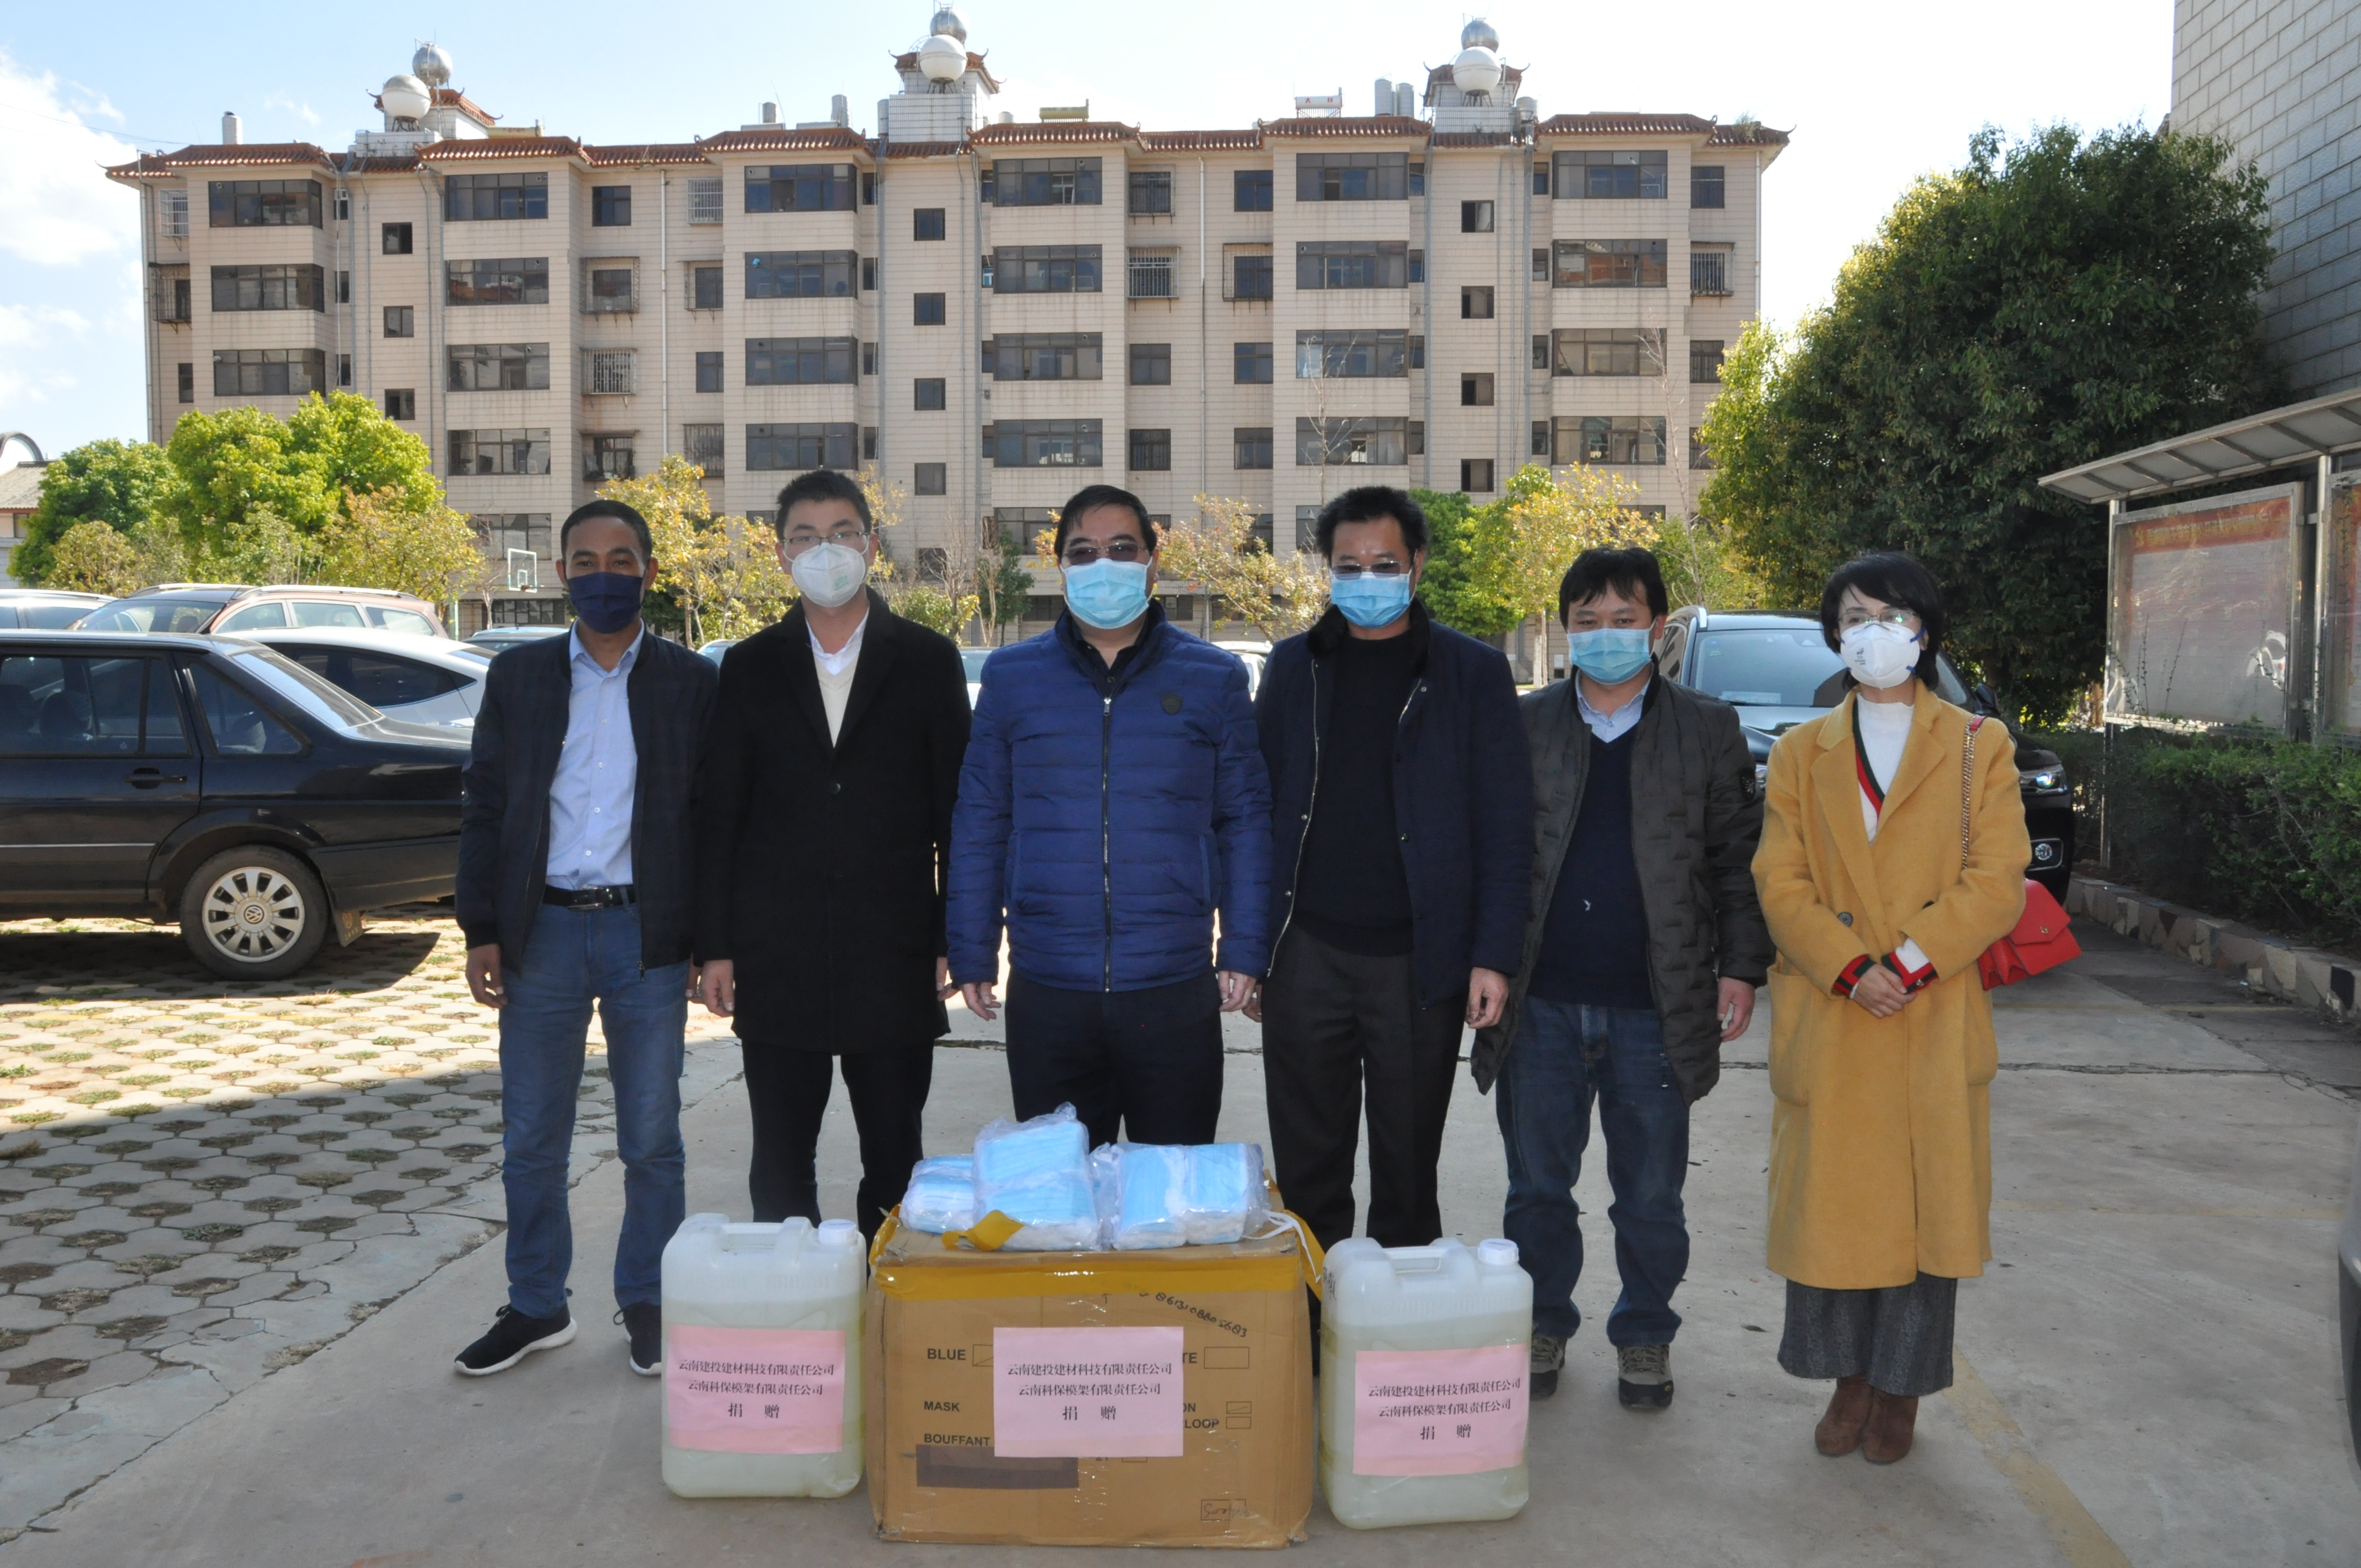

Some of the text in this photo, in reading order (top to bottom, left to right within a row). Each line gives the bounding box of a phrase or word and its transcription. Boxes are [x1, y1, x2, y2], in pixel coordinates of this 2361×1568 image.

[927, 1348, 966, 1360] BLUE
[678, 1359, 834, 1376] 云南建投建材科技有限责任公司
[1008, 1363, 1172, 1376] 云南建投建材科技有限责任公司
[688, 1380, 823, 1395] 云南科保模架有限责任公司
[1019, 1383, 1161, 1396] 云南科保模架有限责任公司
[1368, 1378, 1521, 1397] 云南建投建材科技有限责任公司
[924, 1401, 960, 1412] MASK
[1379, 1398, 1511, 1418] 云南科保模架有限责任公司
[1184, 1419, 1219, 1429] LOOP
[924, 1434, 991, 1446] BOUFFANT
